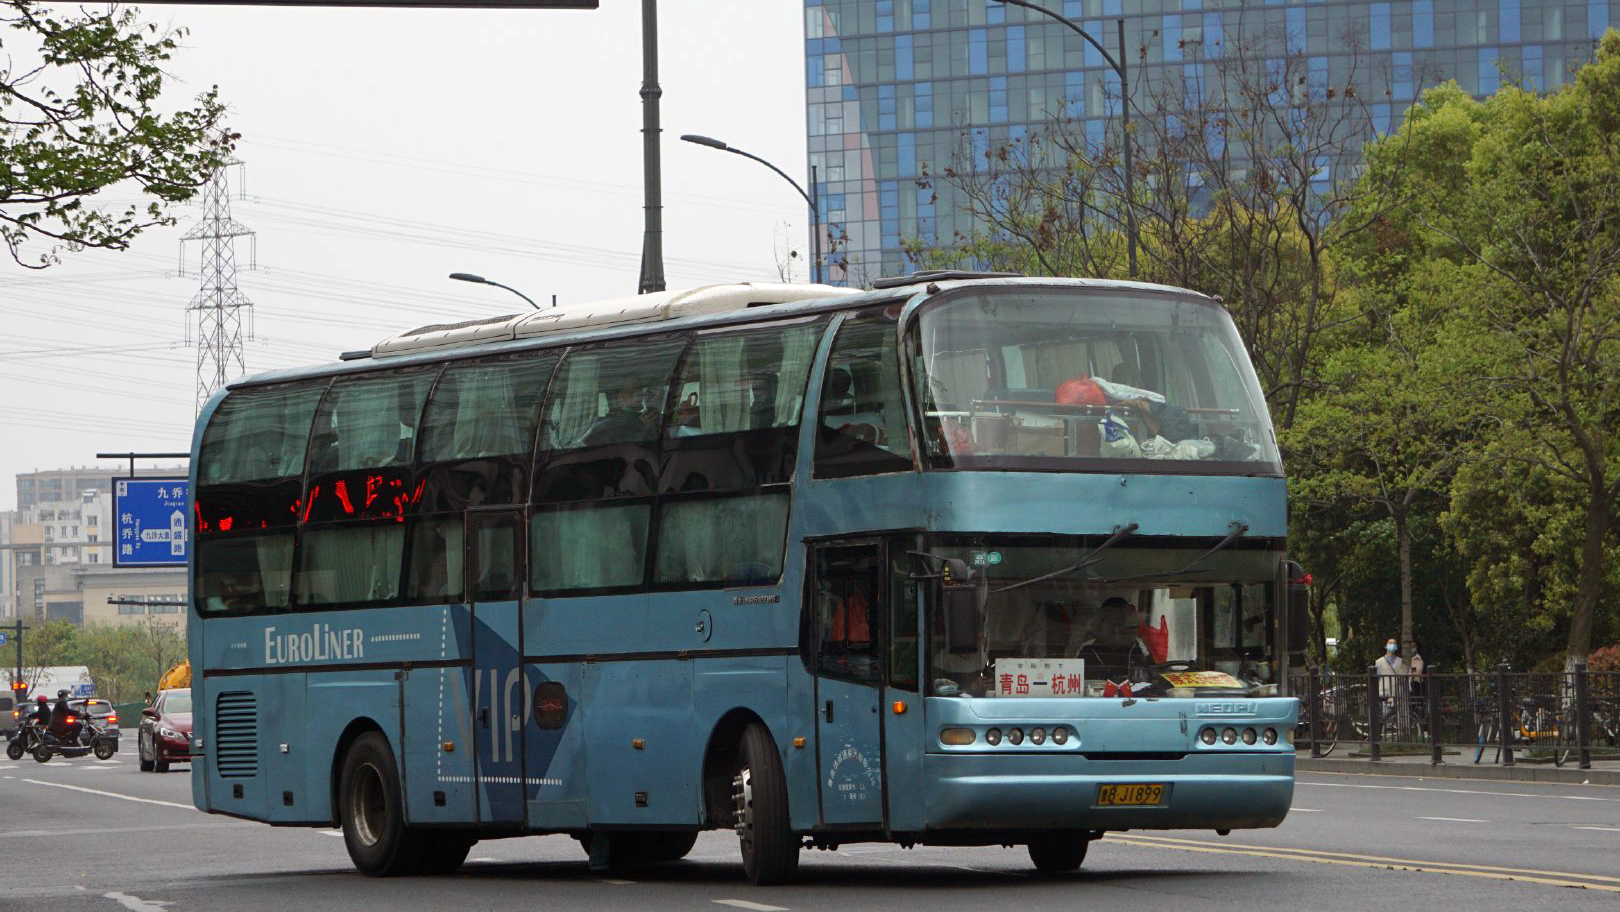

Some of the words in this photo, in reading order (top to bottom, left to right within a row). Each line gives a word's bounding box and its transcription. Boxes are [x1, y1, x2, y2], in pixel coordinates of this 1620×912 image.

[158, 487, 188, 498] 九乔
[122, 513, 133, 555] 杭乔路
[451, 667, 532, 763] VIP
